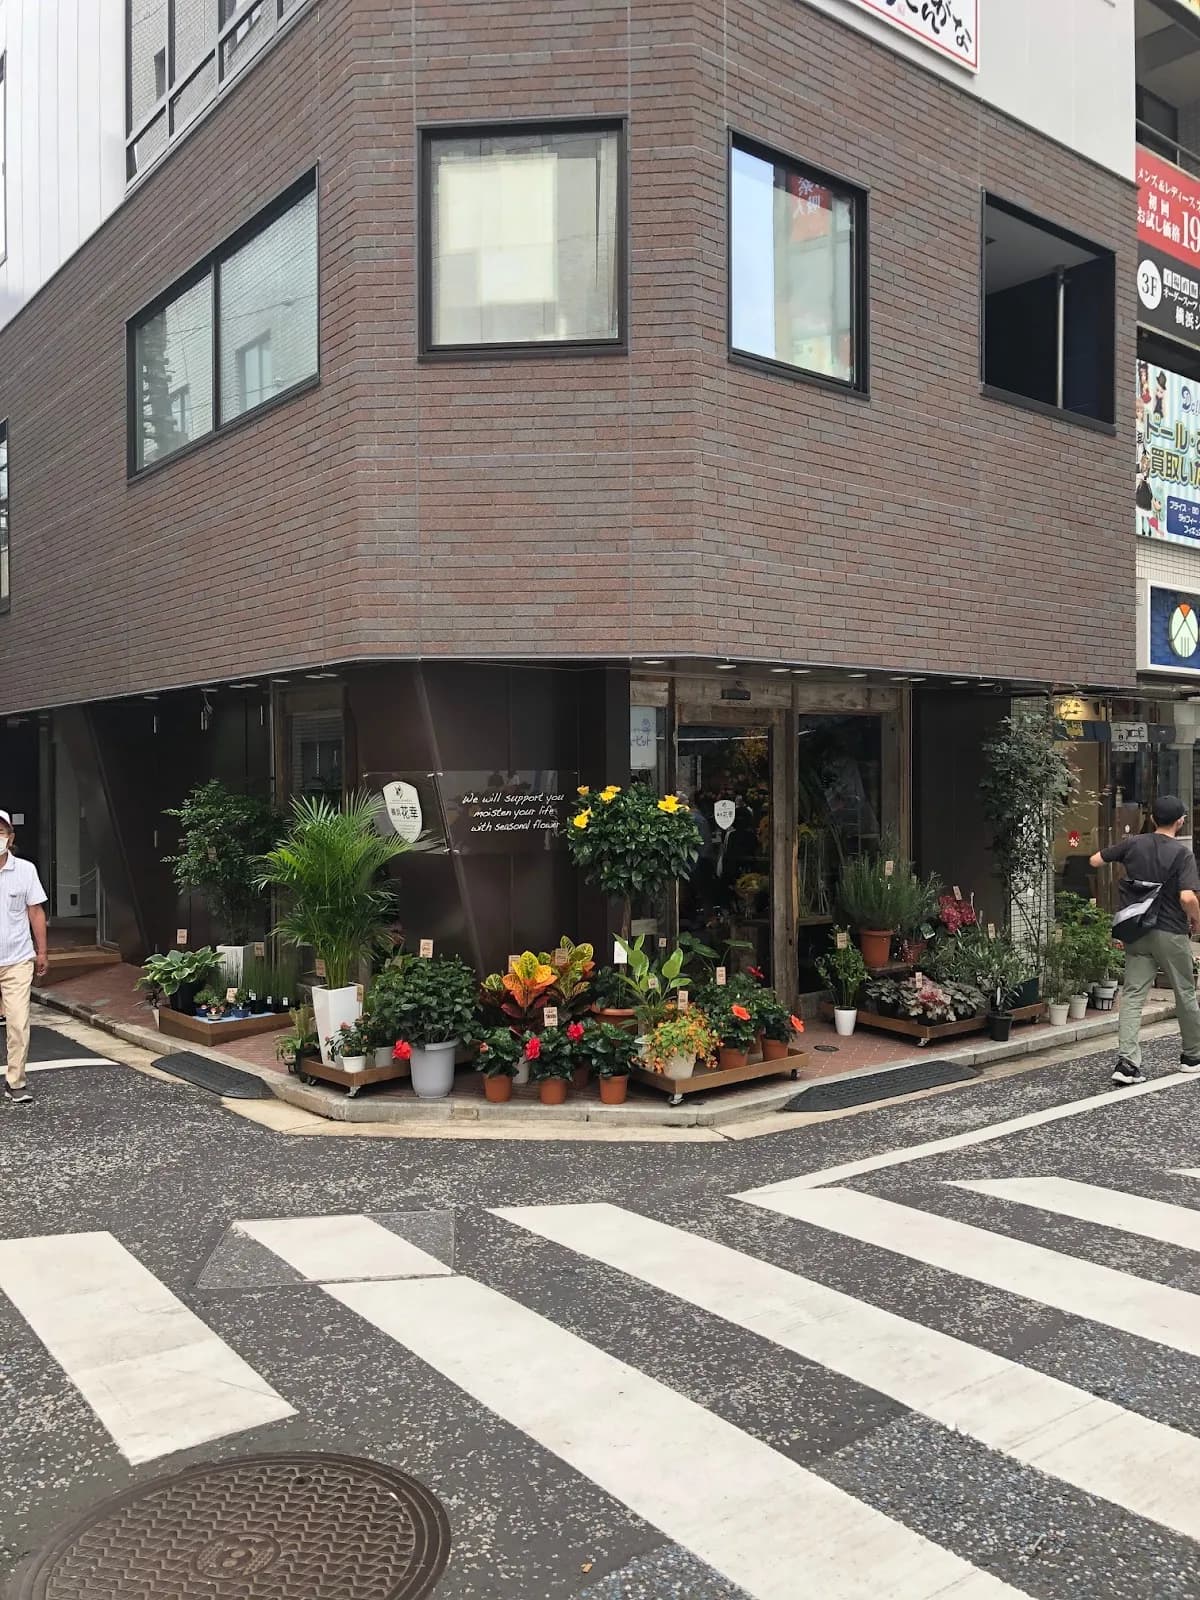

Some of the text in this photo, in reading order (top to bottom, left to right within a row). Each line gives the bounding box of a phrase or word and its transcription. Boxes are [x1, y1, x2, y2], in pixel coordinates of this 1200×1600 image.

[1142, 273, 1158, 297] 3F
[462, 792, 565, 806] We will support you
[473, 805, 554, 820] moisten your life
[470, 821, 492, 832] with
[494, 820, 531, 832] seasonal
